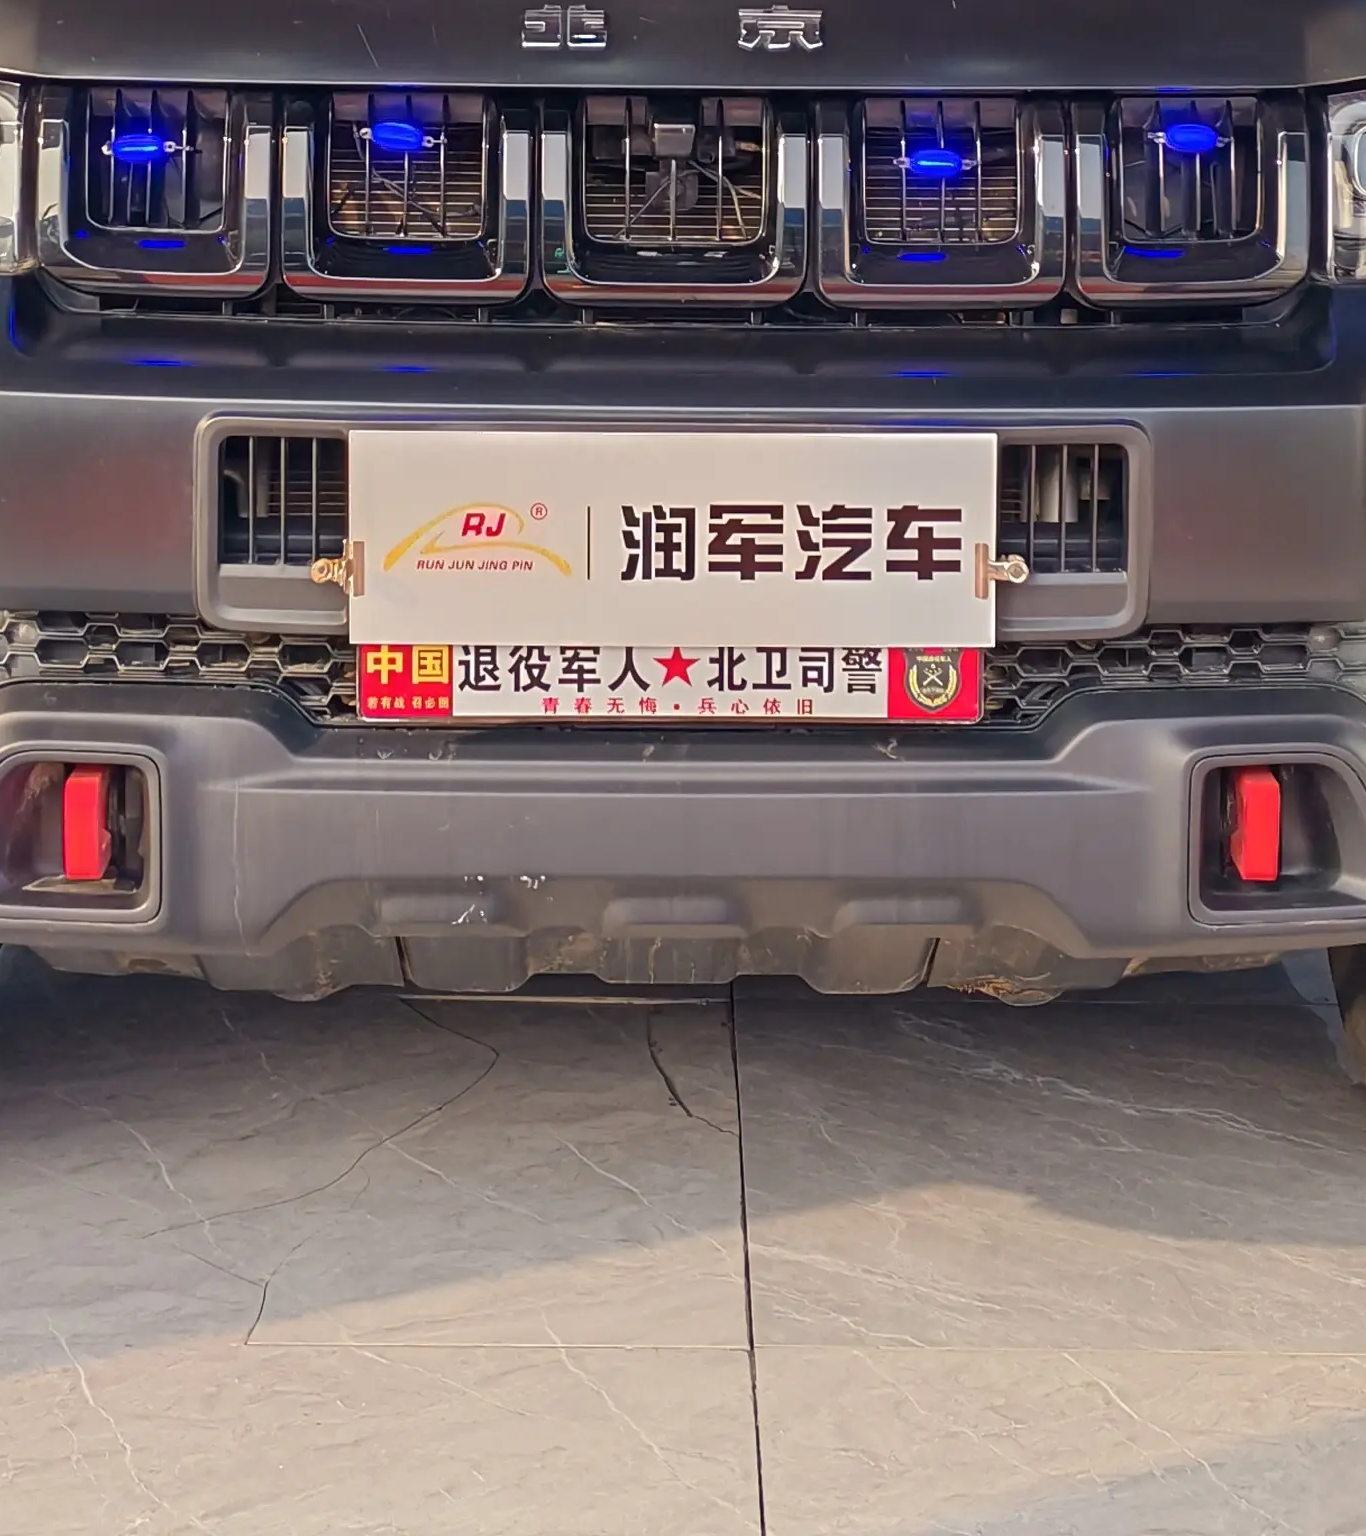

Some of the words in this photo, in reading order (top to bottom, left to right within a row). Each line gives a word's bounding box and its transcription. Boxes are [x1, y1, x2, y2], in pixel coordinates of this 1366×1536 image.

[521, 4, 823, 50] 北京
[461, 512, 506, 537] RJ
[620, 504, 962, 581] 润军汽车
[416, 559, 445, 570] RUN
[448, 560, 475, 571] JUN
[477, 560, 508, 571] JING
[511, 560, 533, 571] PIN
[366, 646, 449, 685] 中国
[458, 646, 651, 693] 退役军人
[706, 647, 883, 694] 北卫司警
